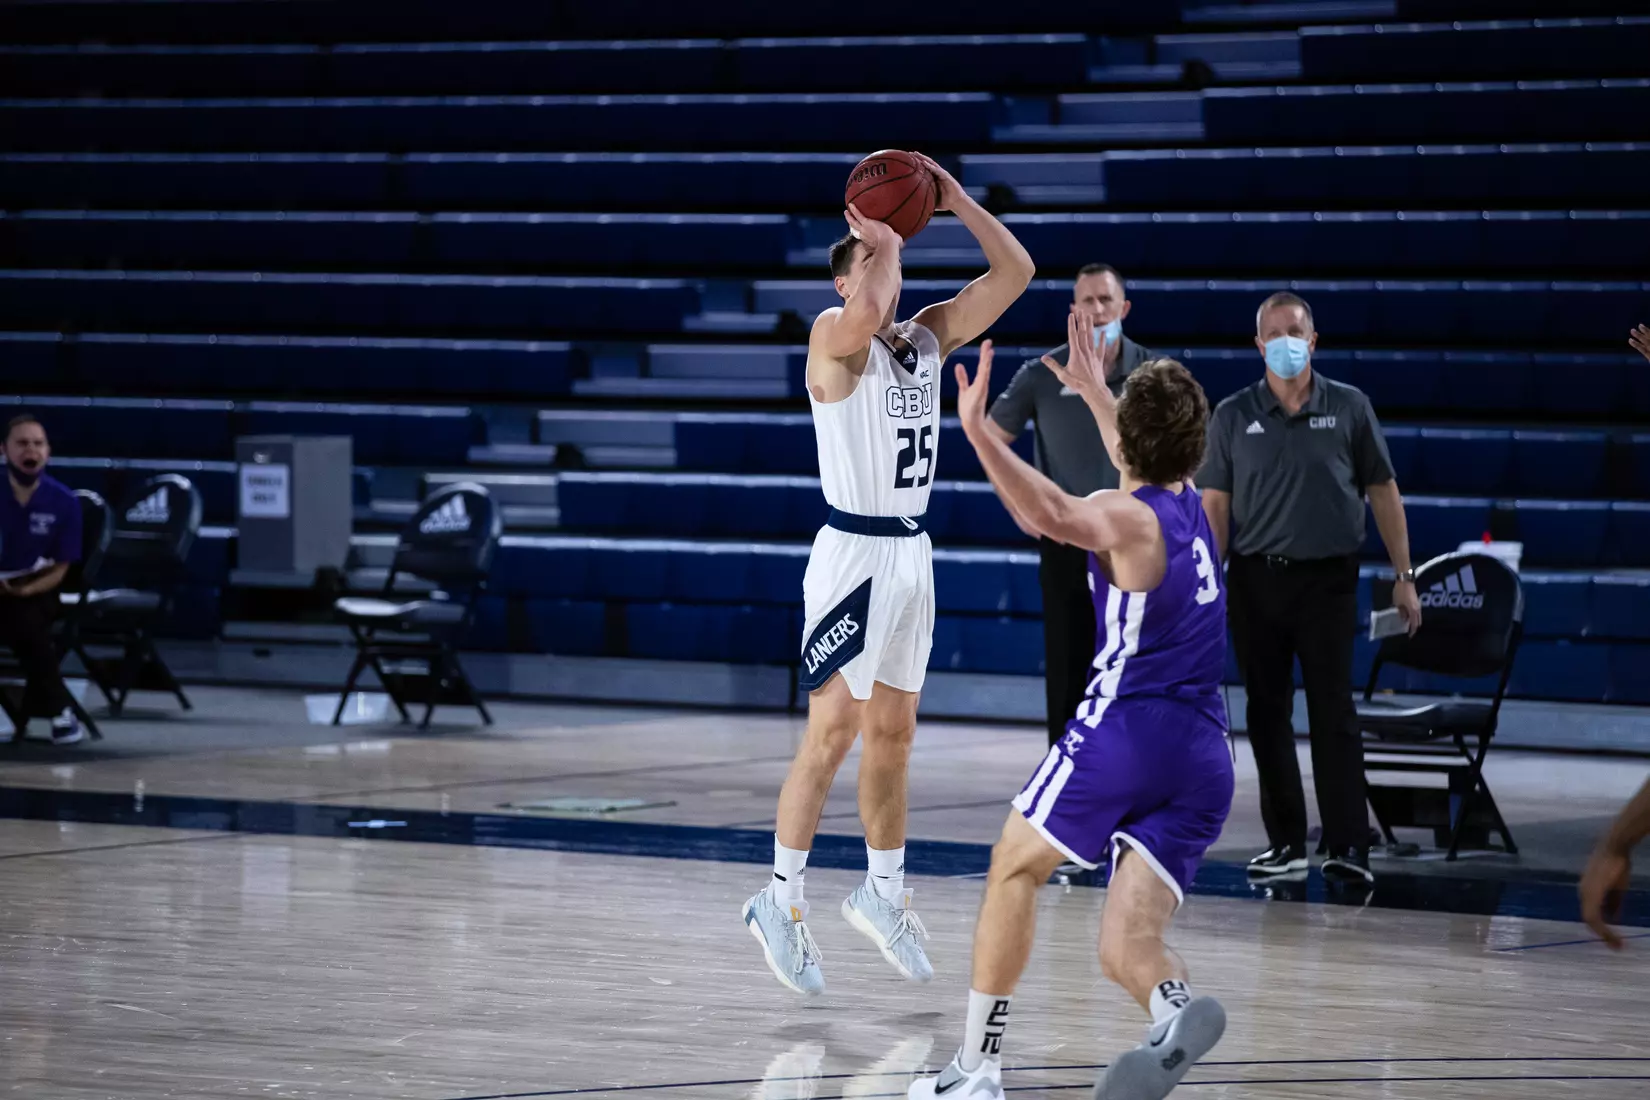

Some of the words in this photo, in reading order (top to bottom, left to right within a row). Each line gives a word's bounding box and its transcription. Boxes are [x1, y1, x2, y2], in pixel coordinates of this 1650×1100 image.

[886, 382, 933, 419] CBU
[894, 425, 933, 489] 25
[1191, 536, 1220, 606] 3
[1419, 589, 1485, 610] adidas
[805, 612, 860, 675] LANCERS
